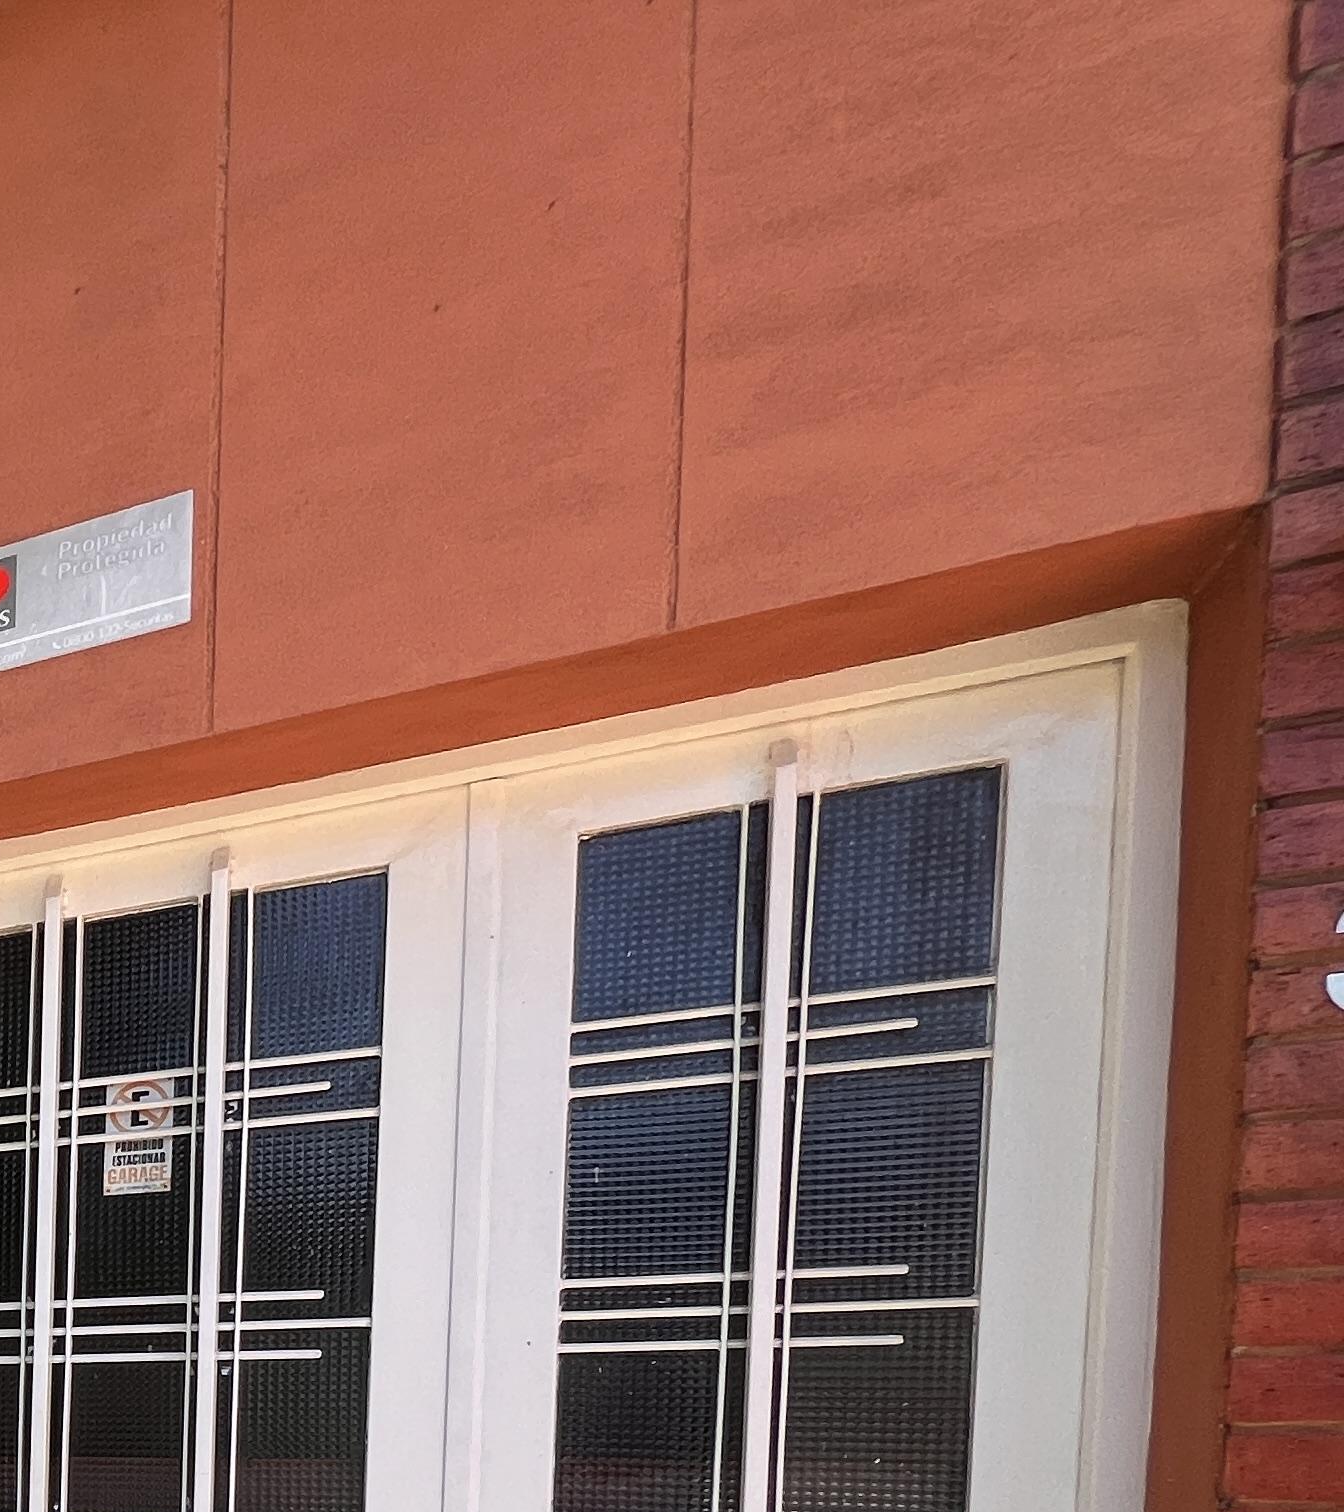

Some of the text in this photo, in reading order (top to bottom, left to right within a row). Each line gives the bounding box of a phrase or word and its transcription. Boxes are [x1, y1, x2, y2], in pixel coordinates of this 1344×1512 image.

[59, 513, 172, 559] Propiedad
[58, 540, 166, 580] Protegida
[115, 1139, 163, 1153] PROHIBIDO
[112, 1152, 166, 1167] ESTACIONAR
[107, 1165, 169, 1185] GARAGE
